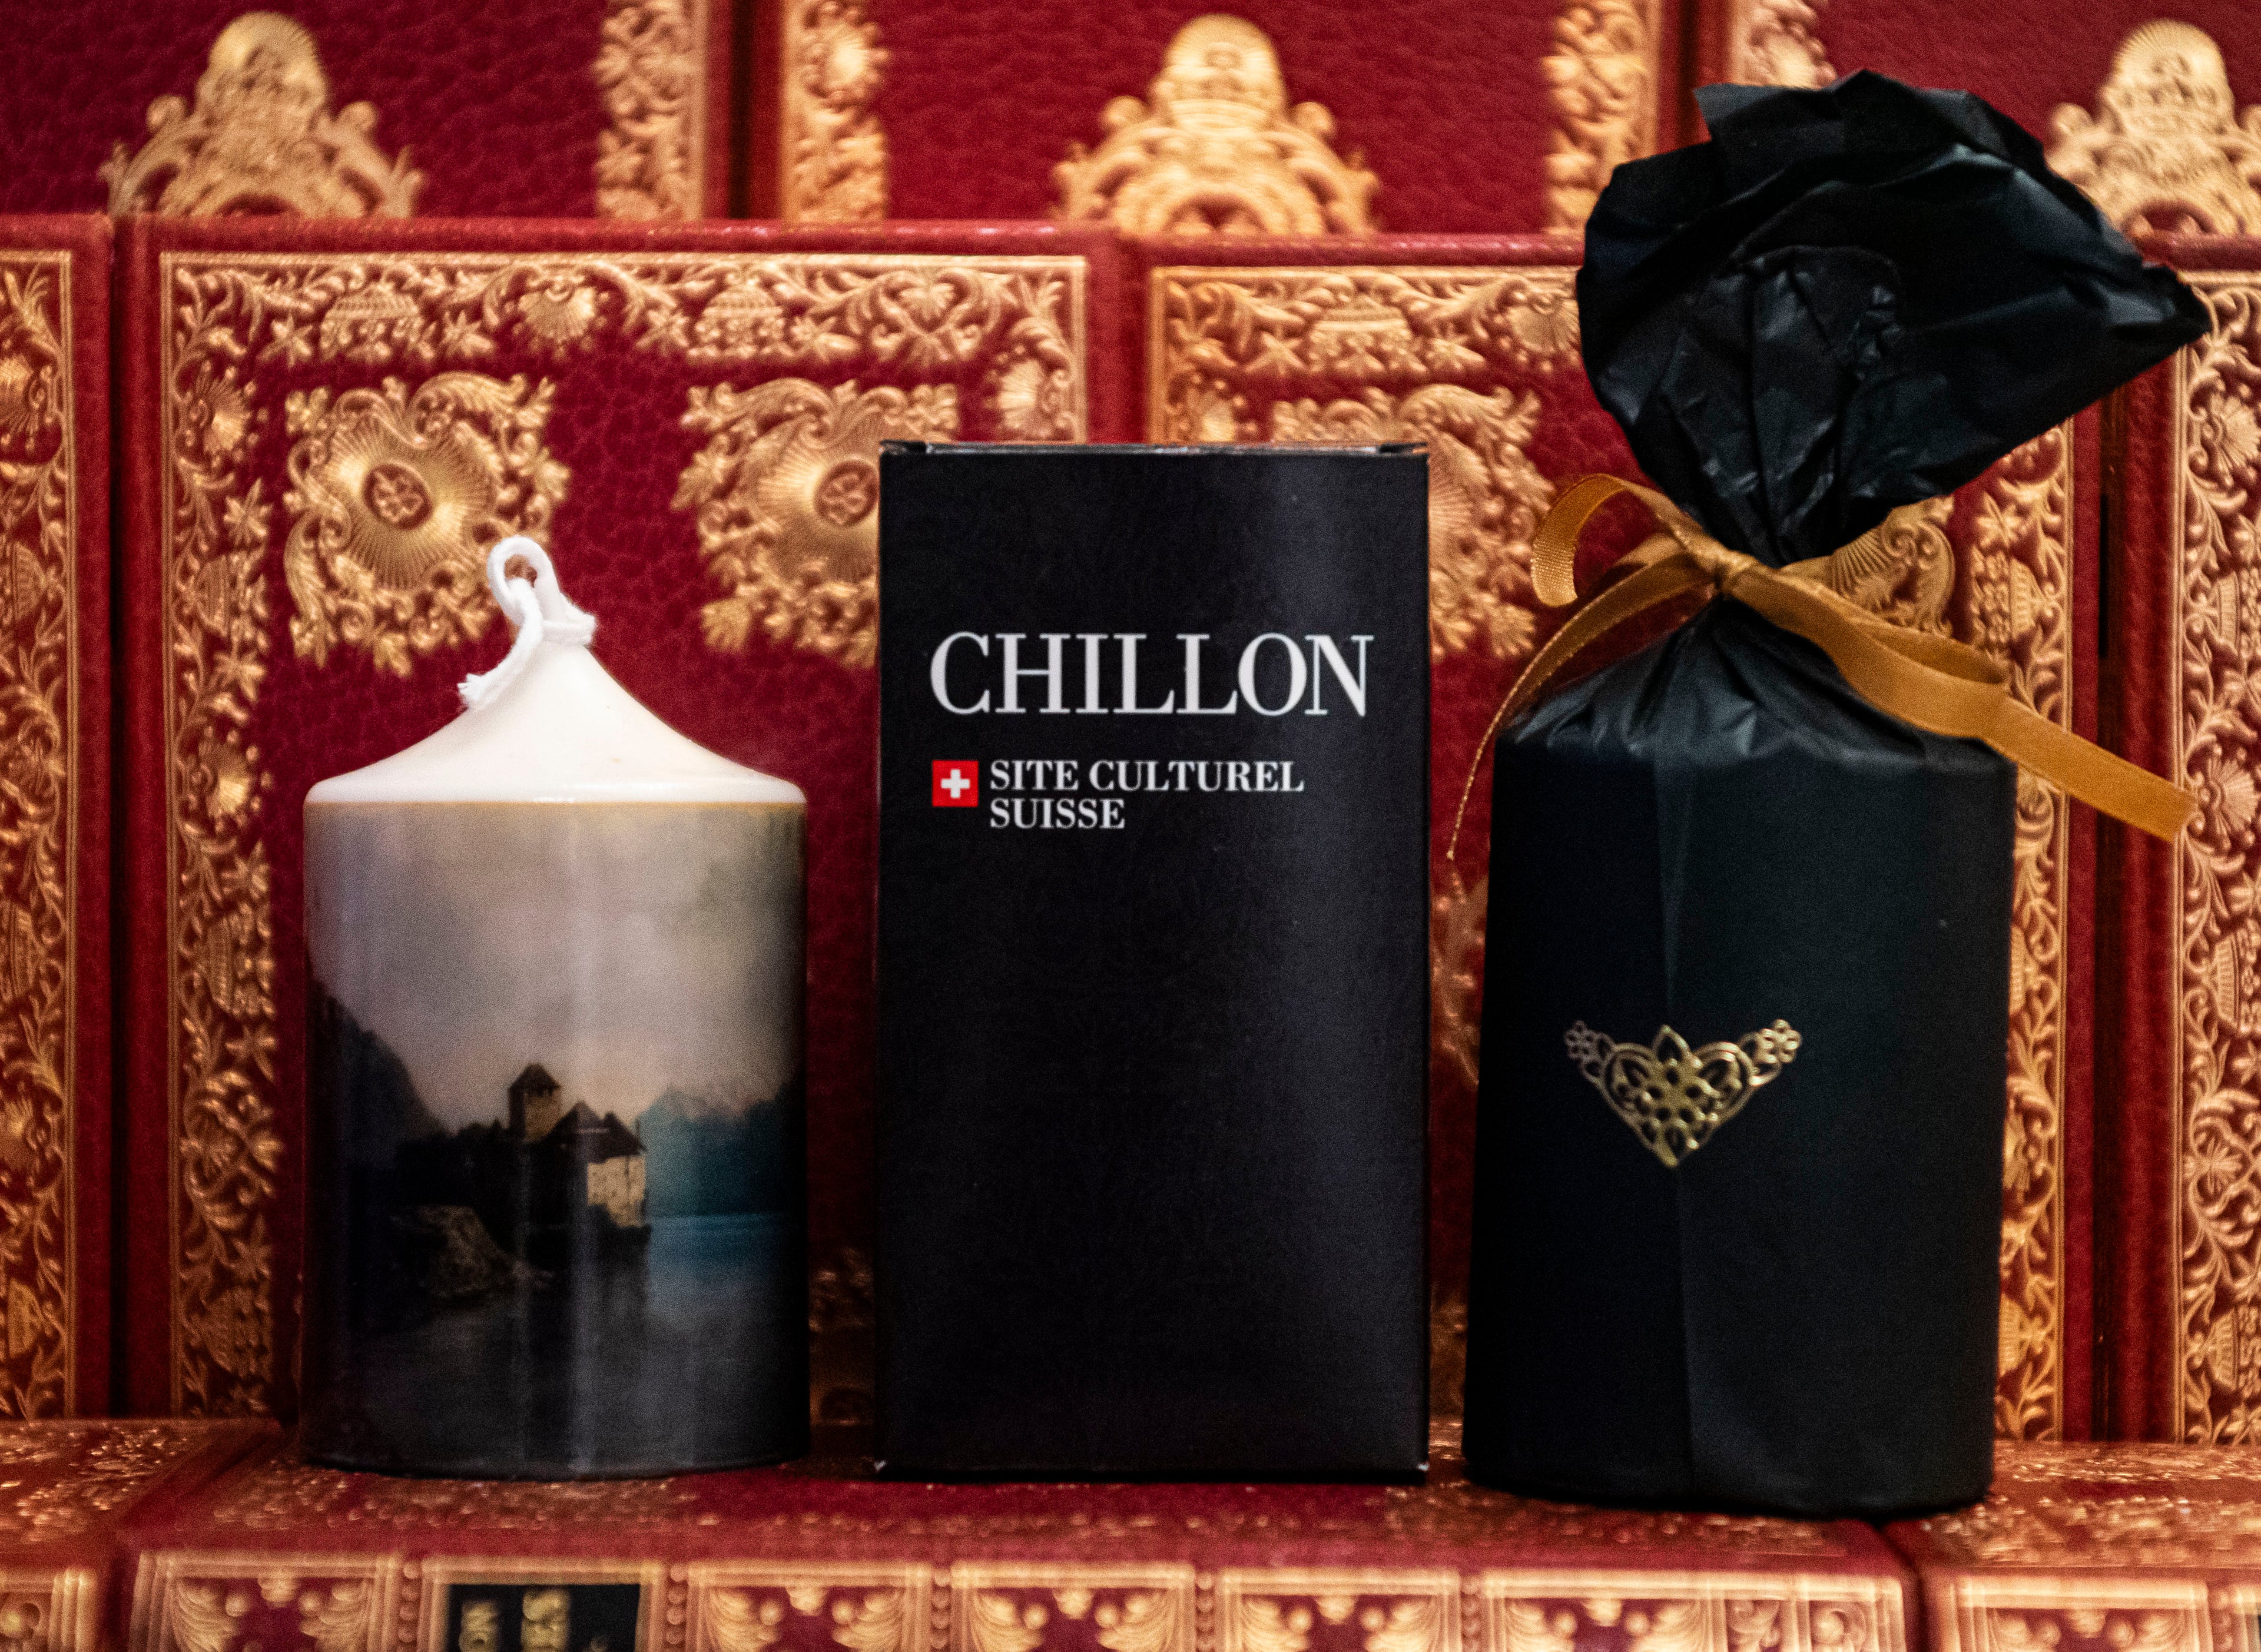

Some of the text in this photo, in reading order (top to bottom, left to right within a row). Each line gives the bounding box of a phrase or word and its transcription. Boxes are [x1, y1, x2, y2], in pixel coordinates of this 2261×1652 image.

[930, 632, 1375, 717] CHILLON
[990, 760, 1304, 792] SITE CULTUREL
[990, 798, 1125, 830] SUISSE
